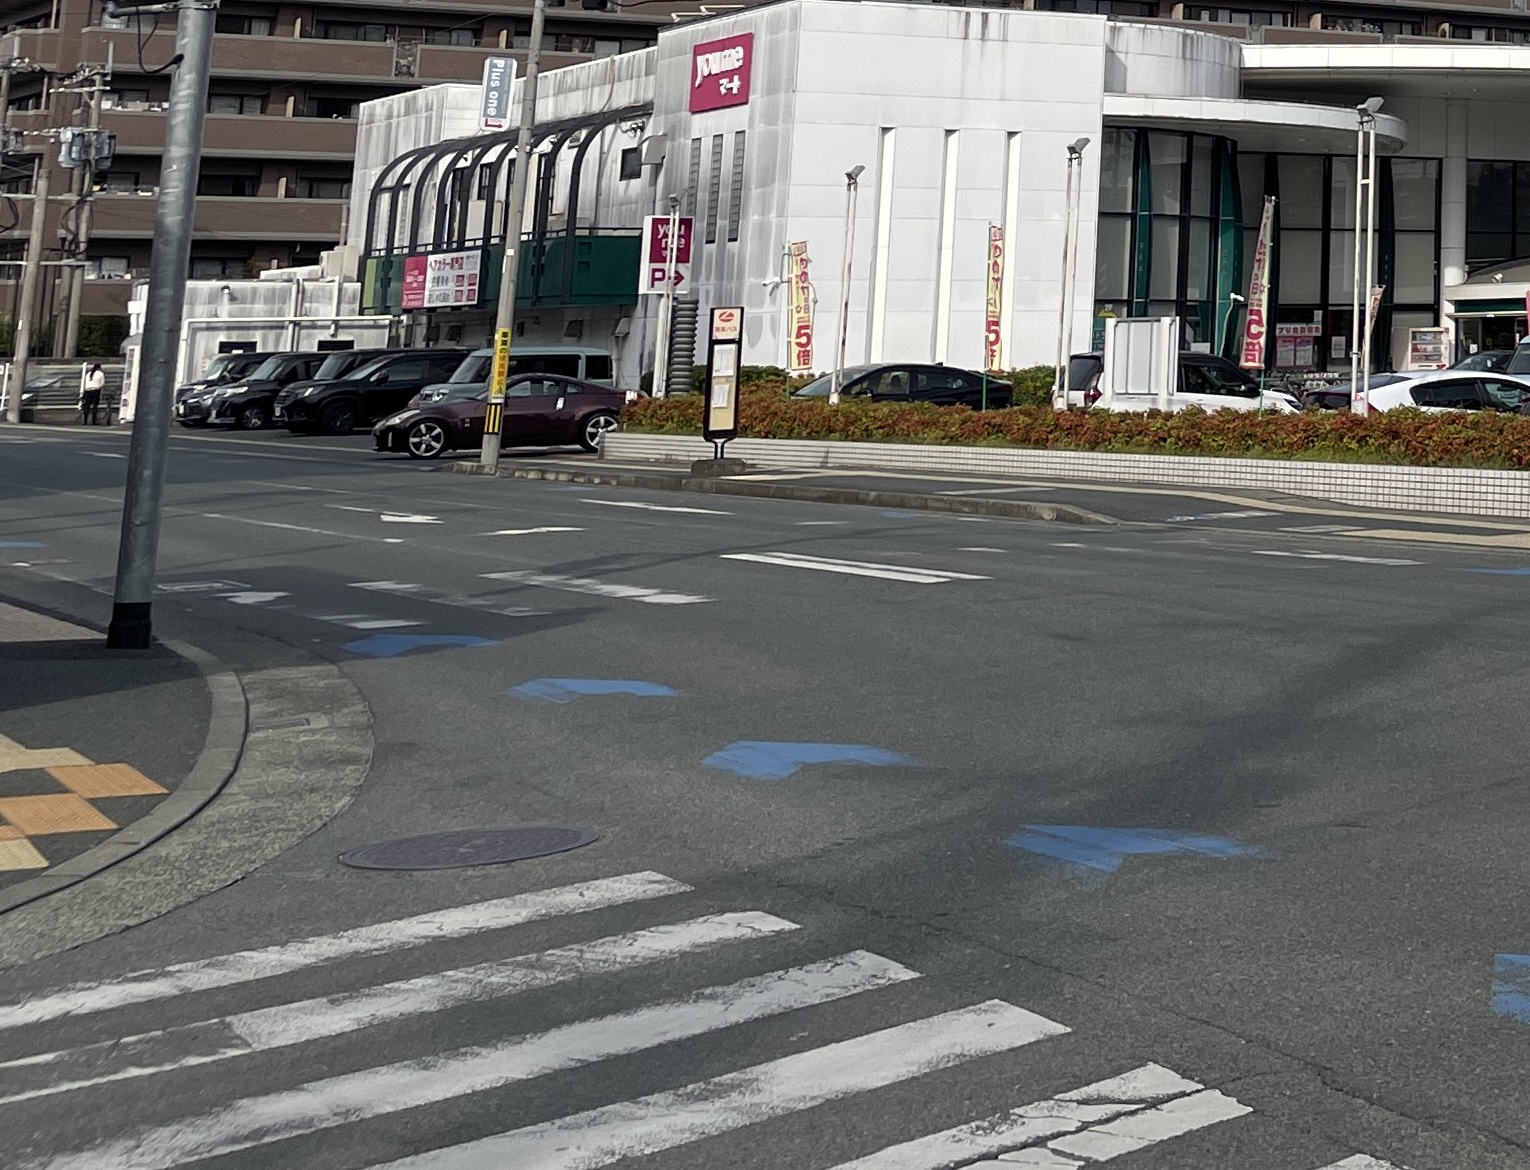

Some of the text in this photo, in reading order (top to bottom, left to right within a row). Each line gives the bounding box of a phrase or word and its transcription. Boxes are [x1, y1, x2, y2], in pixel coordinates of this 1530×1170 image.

[491, 59, 505, 87] Plus
[487, 91, 499, 116] one
[651, 268, 666, 288] P
